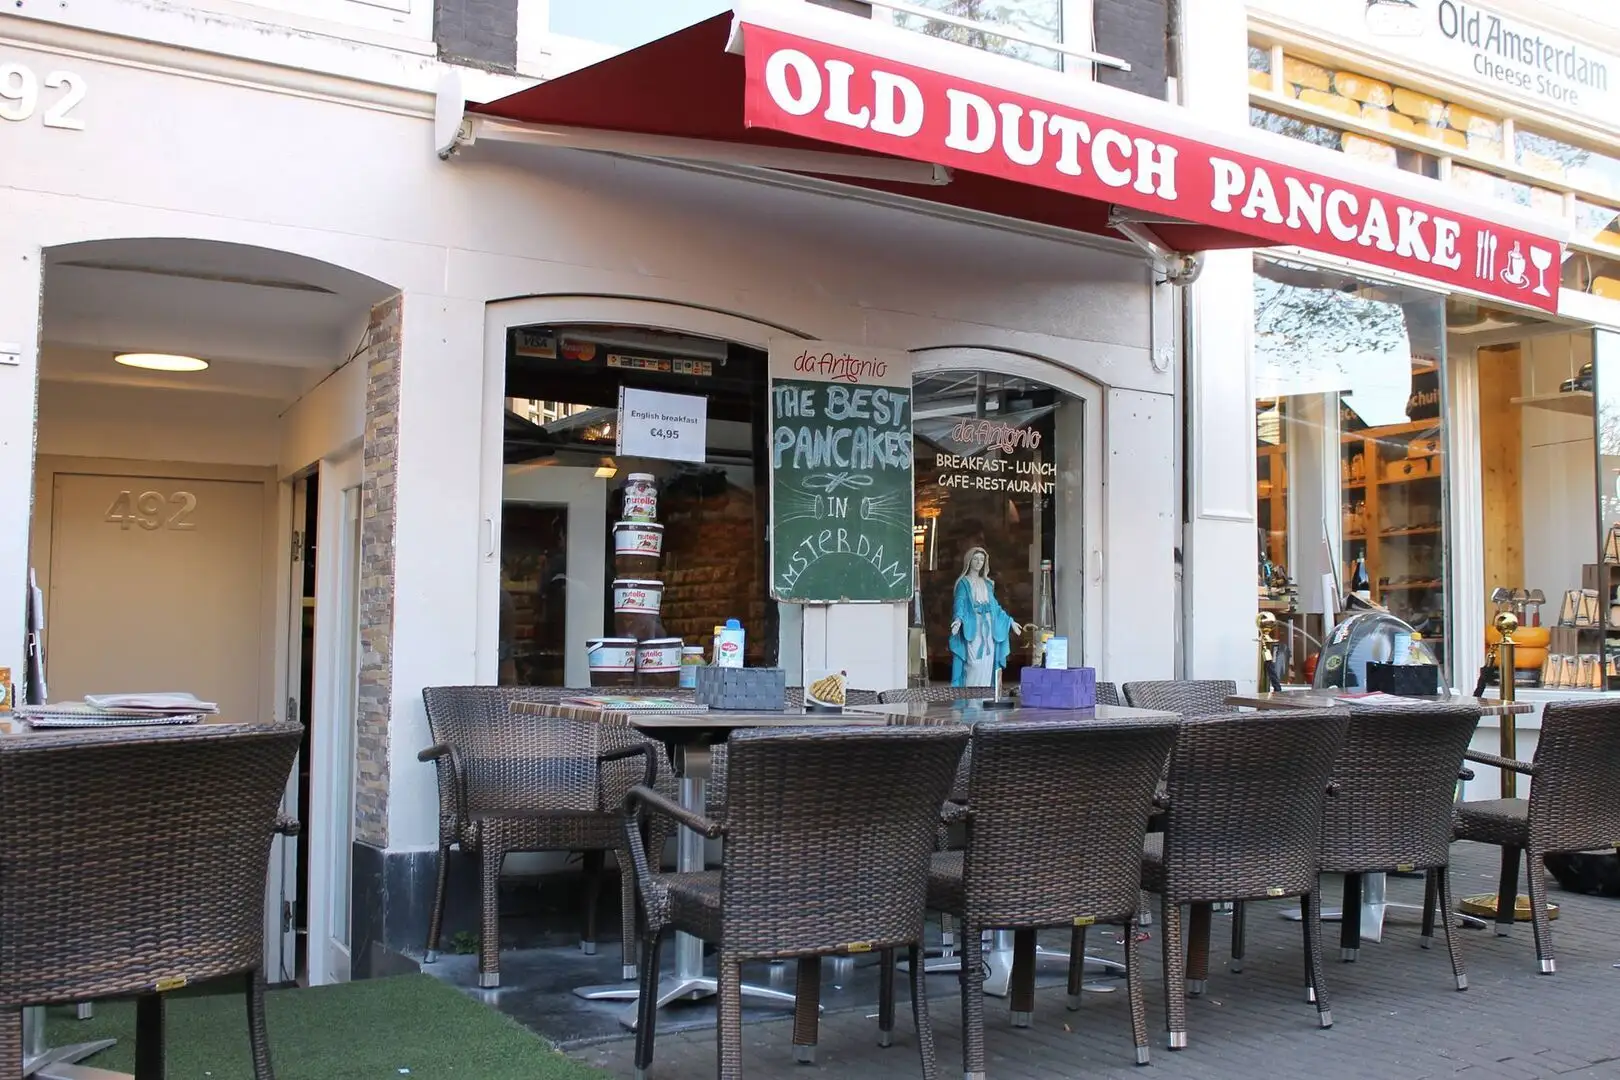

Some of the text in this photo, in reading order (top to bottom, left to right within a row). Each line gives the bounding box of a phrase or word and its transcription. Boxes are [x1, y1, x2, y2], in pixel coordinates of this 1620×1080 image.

[1439, 0, 1607, 91] Old Amsterdam
[1474, 53, 1578, 105] Cheese Store
[765, 48, 1461, 271] OLD DUTCH PANCAKE
[794, 350, 888, 383] da Antonio
[631, 410, 698, 424] English breakfast
[773, 385, 909, 426] THE BEST
[650, 427, 679, 440] €4,95
[952, 419, 1042, 454] da Antonio
[104, 490, 196, 531] 492
[626, 497, 656, 505] nutella
[827, 496, 848, 518] IN
